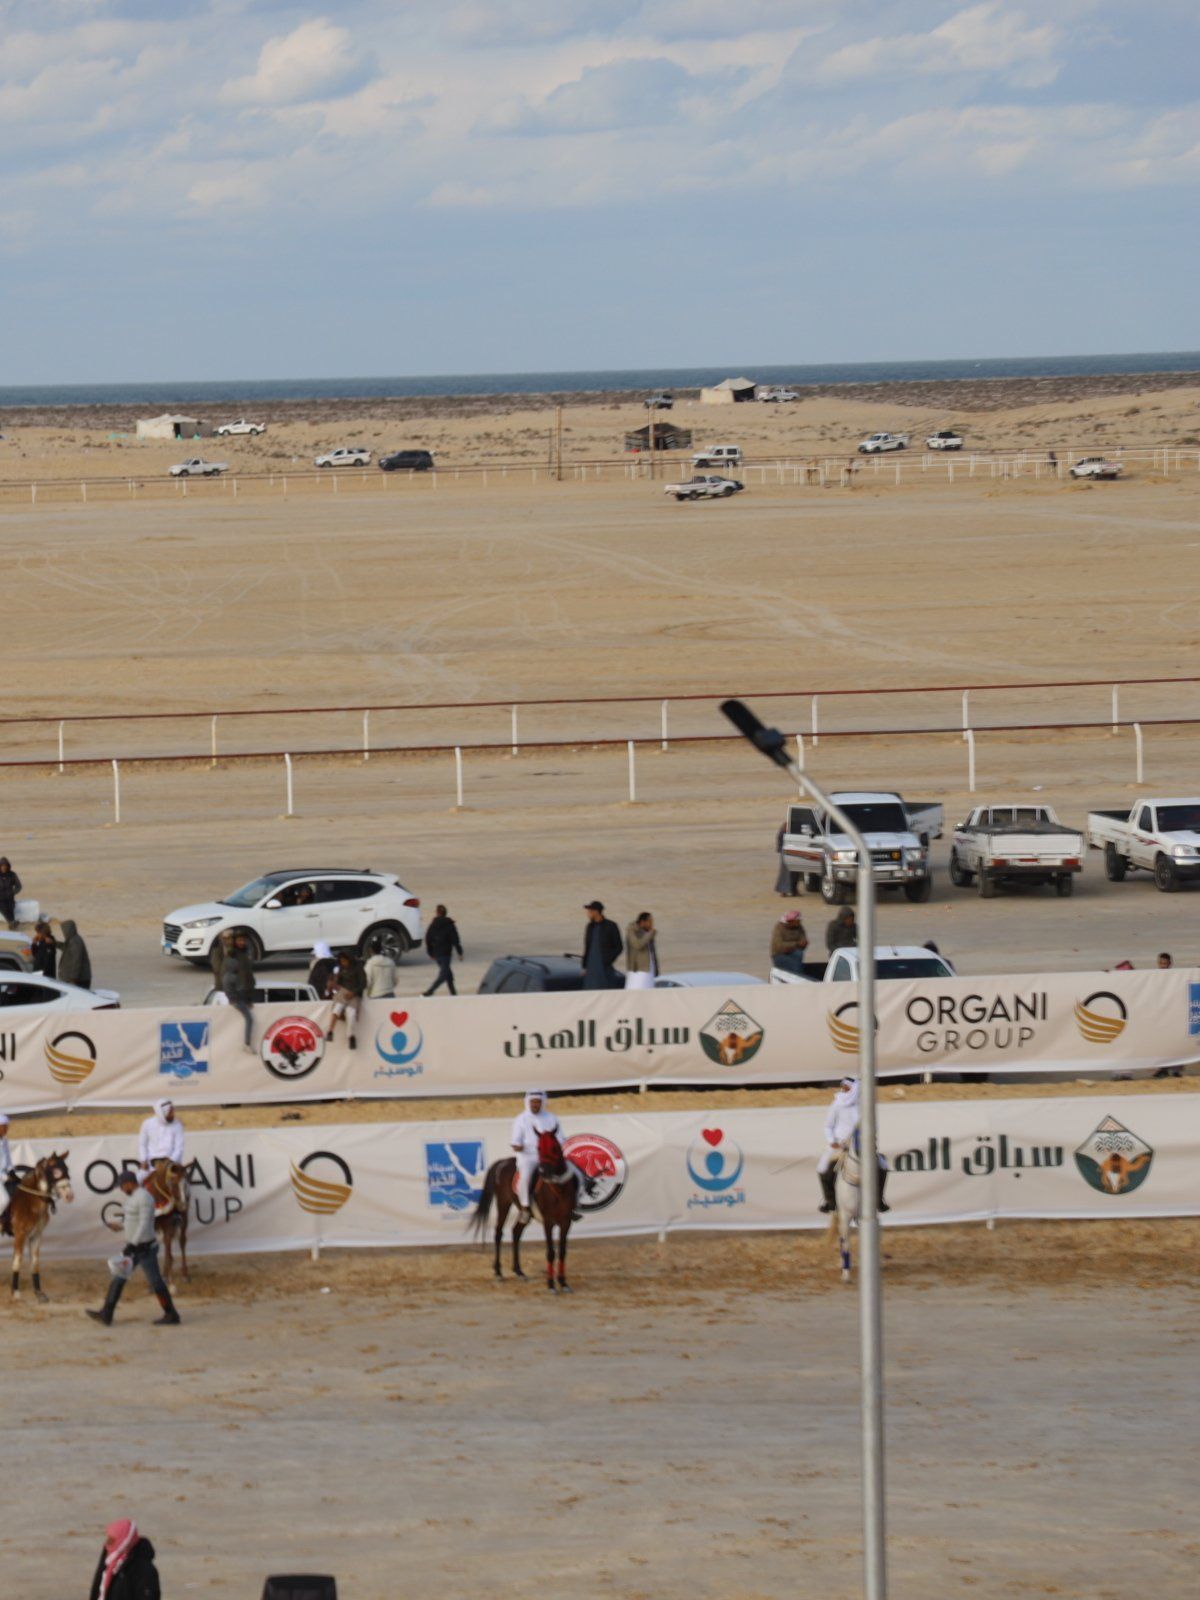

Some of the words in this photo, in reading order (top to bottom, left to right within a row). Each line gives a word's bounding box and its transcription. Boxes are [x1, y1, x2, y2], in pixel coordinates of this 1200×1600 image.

[905, 992, 1048, 1026] ORGANI
[504, 1019, 596, 1058] الهجن
[605, 1018, 690, 1053] سباق
[916, 1027, 1035, 1052] GROUP
[886, 1136, 951, 1172] اله
[963, 1134, 1063, 1178] سباق
[85, 1154, 255, 1194] OANI
[101, 1196, 243, 1231] GUP
